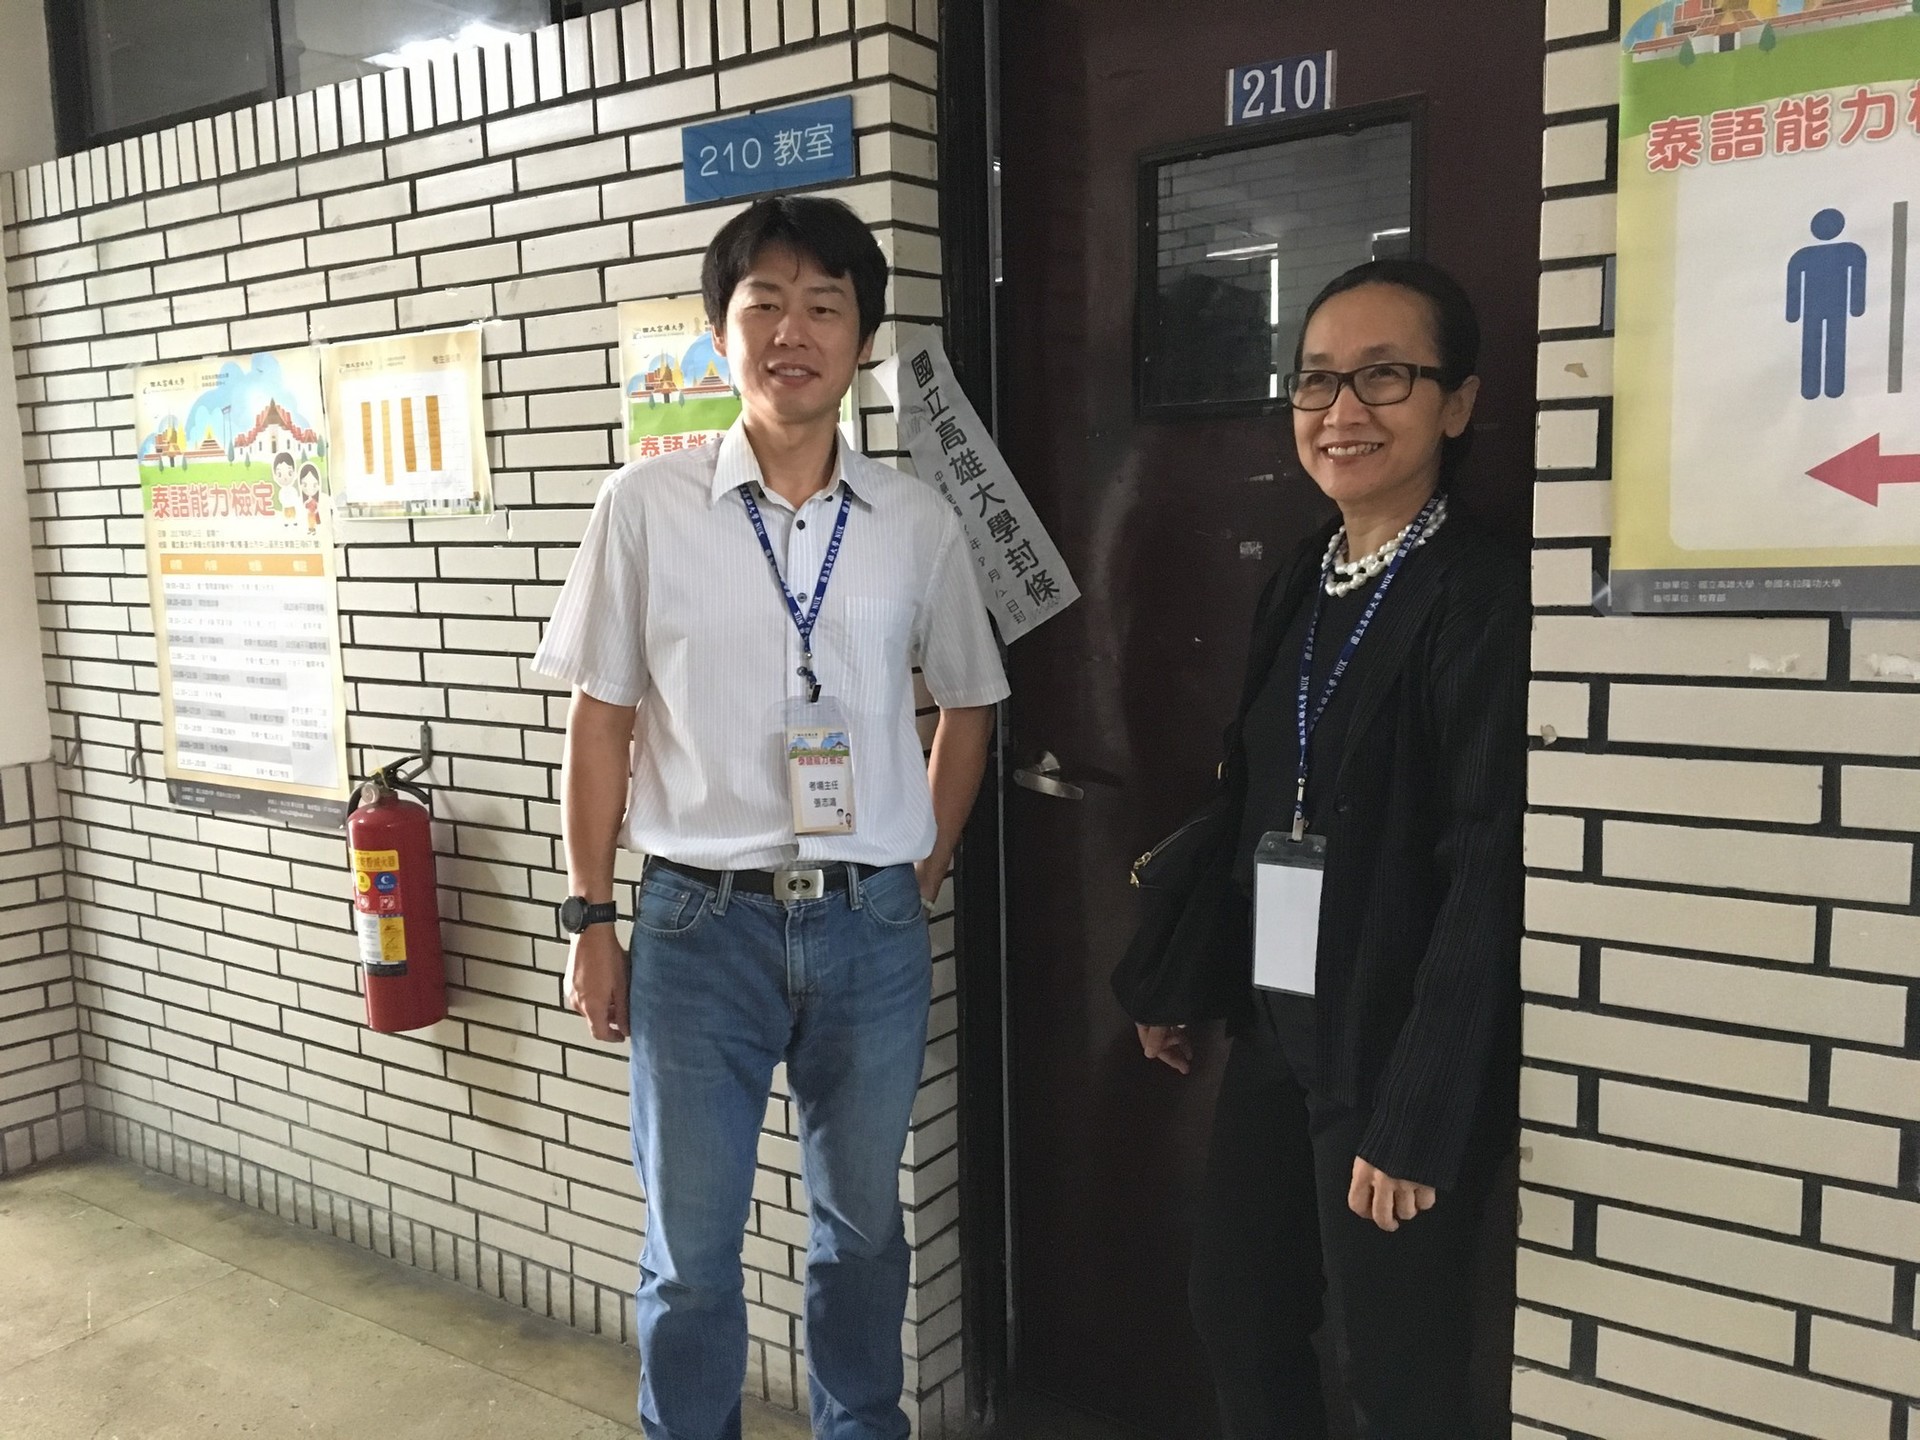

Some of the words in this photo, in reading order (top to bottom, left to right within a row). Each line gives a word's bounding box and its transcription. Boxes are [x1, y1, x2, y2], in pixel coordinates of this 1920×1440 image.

[1242, 59, 1317, 119] 210
[700, 138, 762, 177] 210
[773, 123, 834, 167] 教室
[911, 349, 1060, 607] 國立高雄大學封條
[152, 483, 275, 518] 泰語能力檢定
[755, 521, 765, 537] NUK
[834, 525, 844, 540] NUK
[1398, 510, 1431, 558] 國立高雄大學
[811, 595, 823, 611] NUK
[1350, 592, 1383, 646] 國立高雄大學
[1380, 572, 1395, 590] NUK
[1300, 675, 1310, 691] NUK
[1334, 658, 1349, 678] NUK
